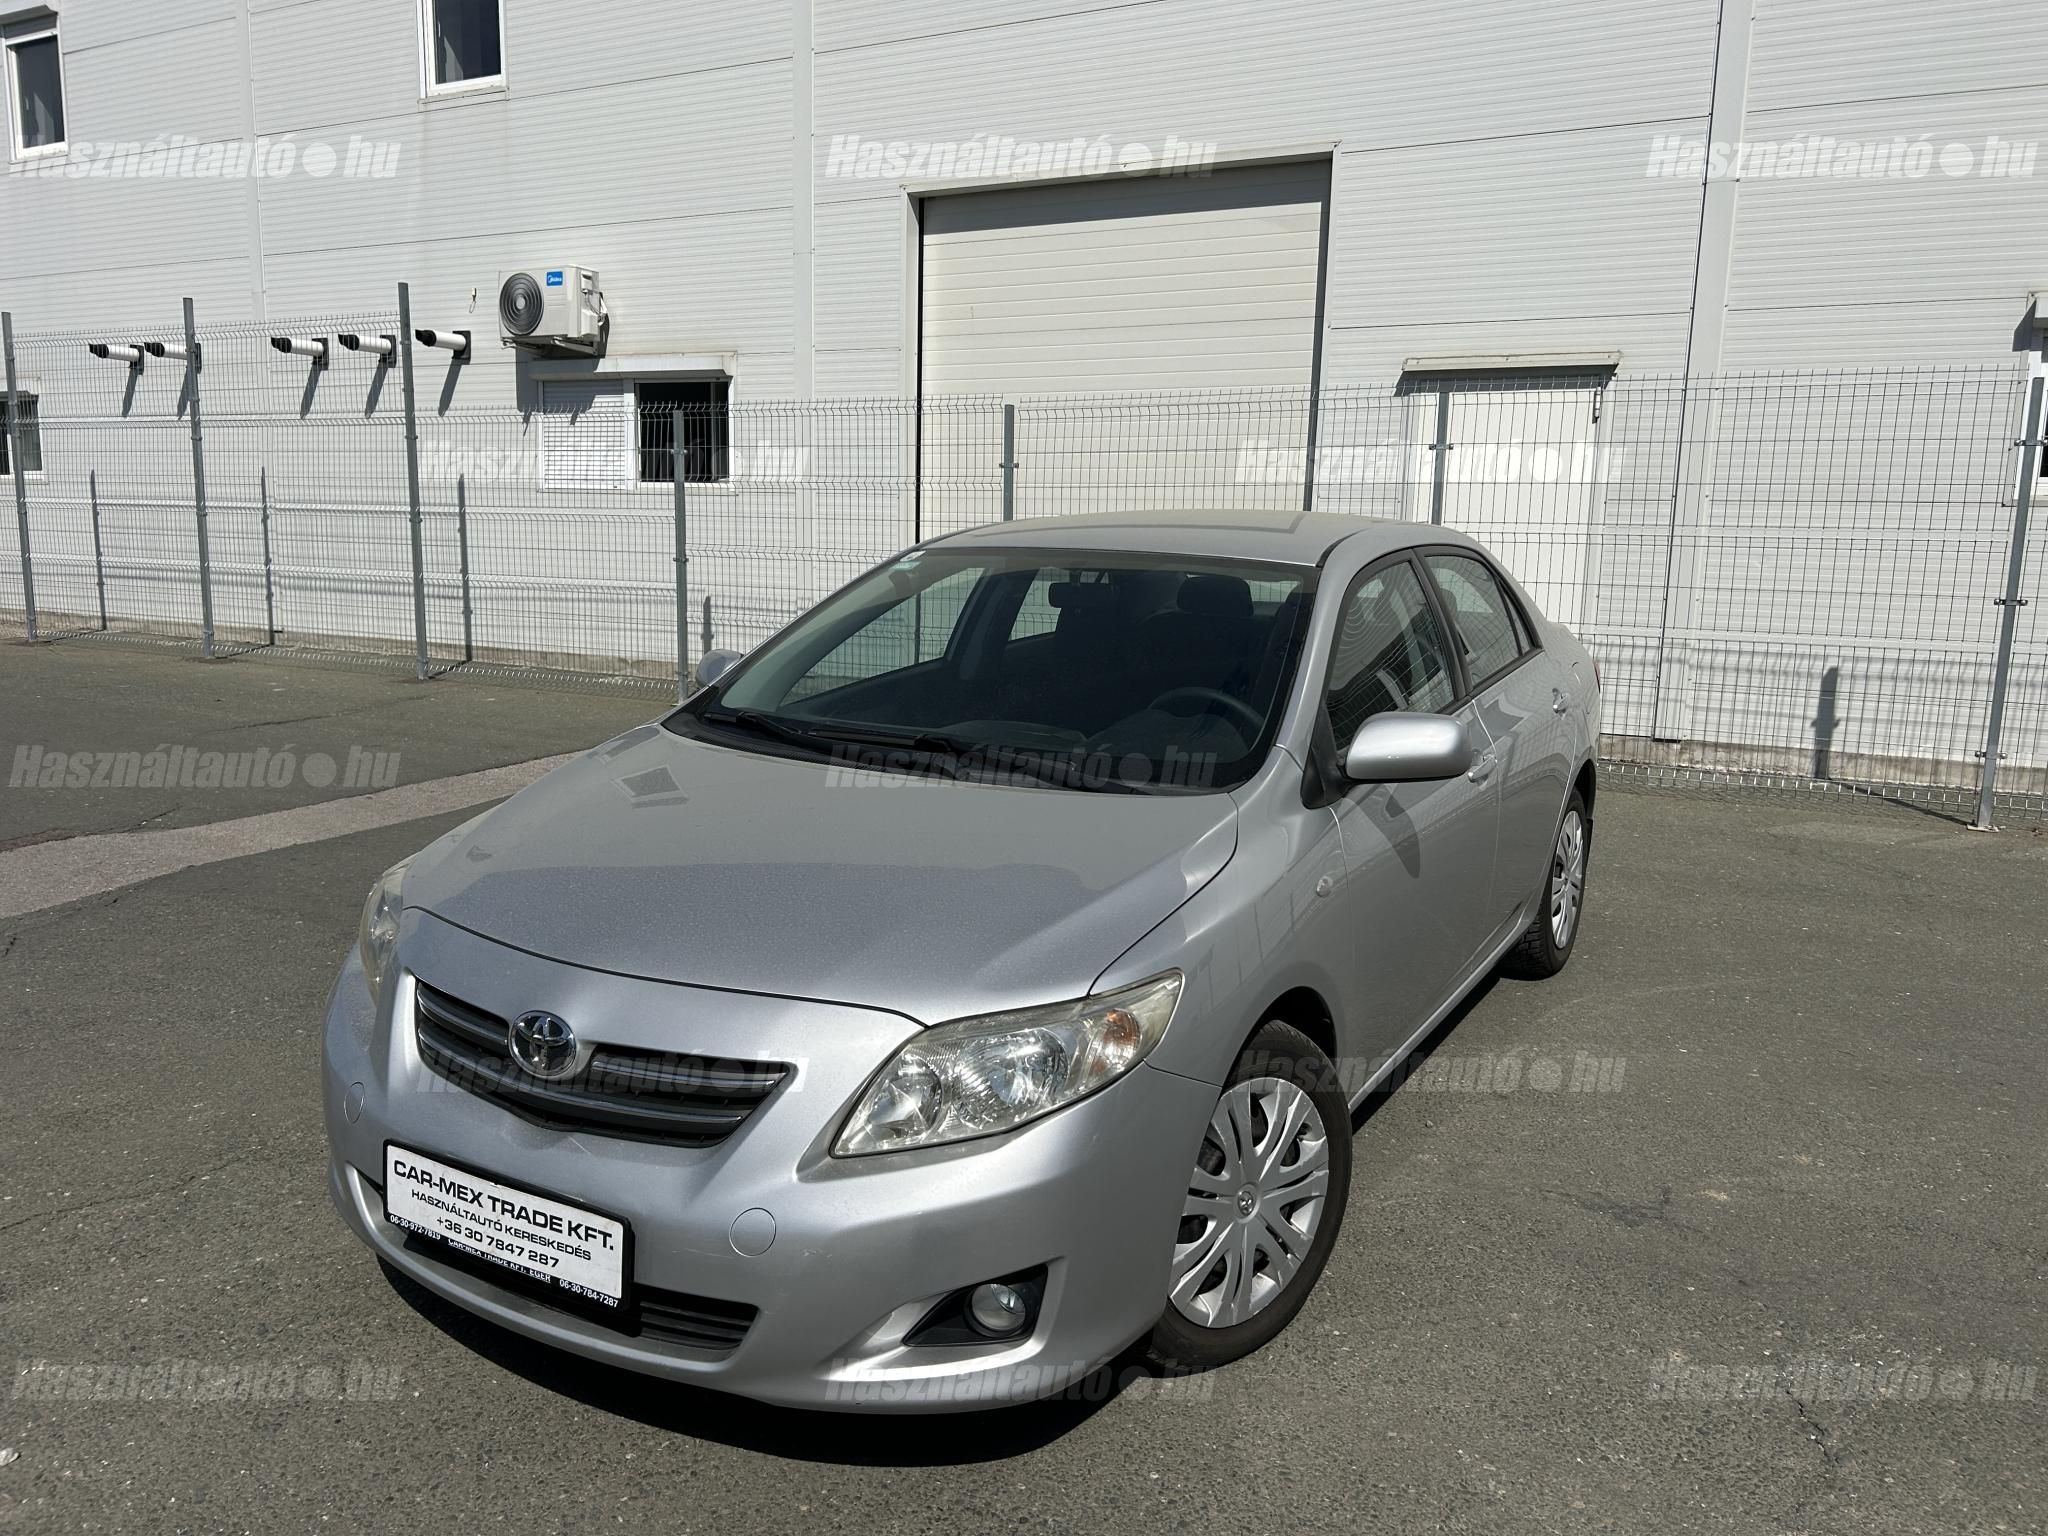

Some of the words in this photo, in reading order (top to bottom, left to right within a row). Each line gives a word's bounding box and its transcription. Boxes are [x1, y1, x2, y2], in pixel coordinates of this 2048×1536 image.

[393, 1159, 485, 1208] CAR-MEX
[488, 1194, 563, 1235] TRADE
[567, 1220, 614, 1251] KFT.
[411, 1188, 503, 1232] HASZNÁLTAUTÓ
[505, 1225, 592, 1261] KERESKEDÉS
[437, 1216, 462, 1234] +36
[464, 1226, 483, 1243] 30
[486, 1235, 525, 1257] 7847
[528, 1250, 560, 1268] 287
[559, 1279, 619, 1308] 06-30-784-7287
